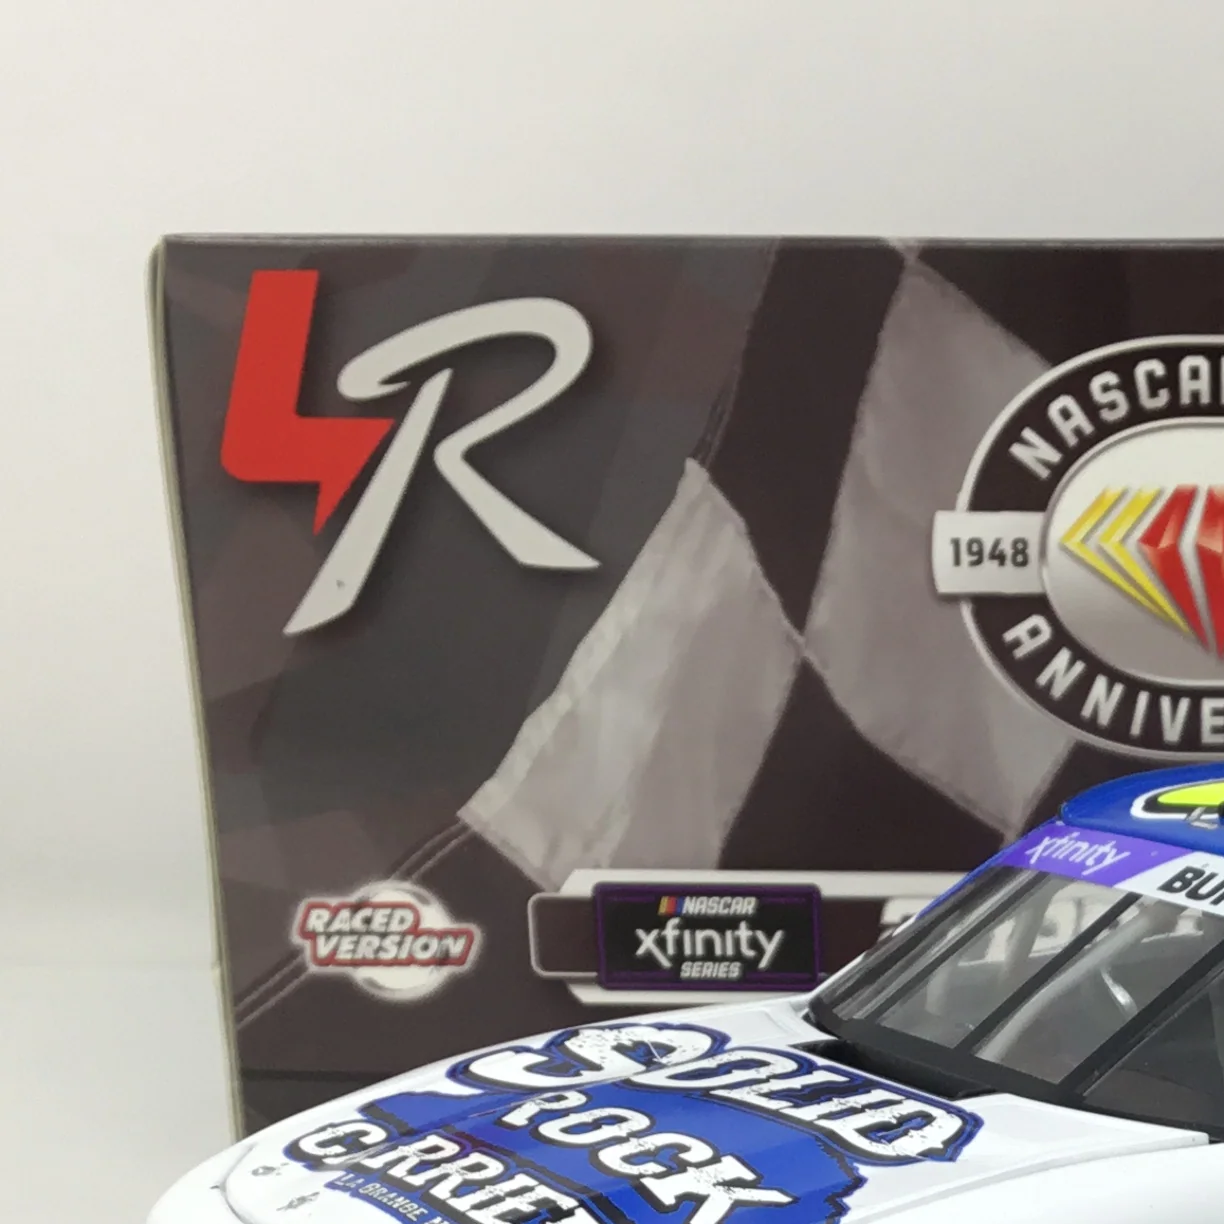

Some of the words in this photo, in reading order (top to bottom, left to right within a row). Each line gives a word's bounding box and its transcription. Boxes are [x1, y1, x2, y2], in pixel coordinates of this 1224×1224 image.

[949, 536, 1030, 569] 1948
[1025, 831, 1132, 876] xfinity
[305, 907, 415, 933] RACED
[682, 896, 759, 916] NASCAR
[315, 934, 468, 960] VERSION
[635, 917, 786, 970] xfinity
[679, 960, 743, 980] SERIES
[456, 1024, 975, 1161] SOLID
